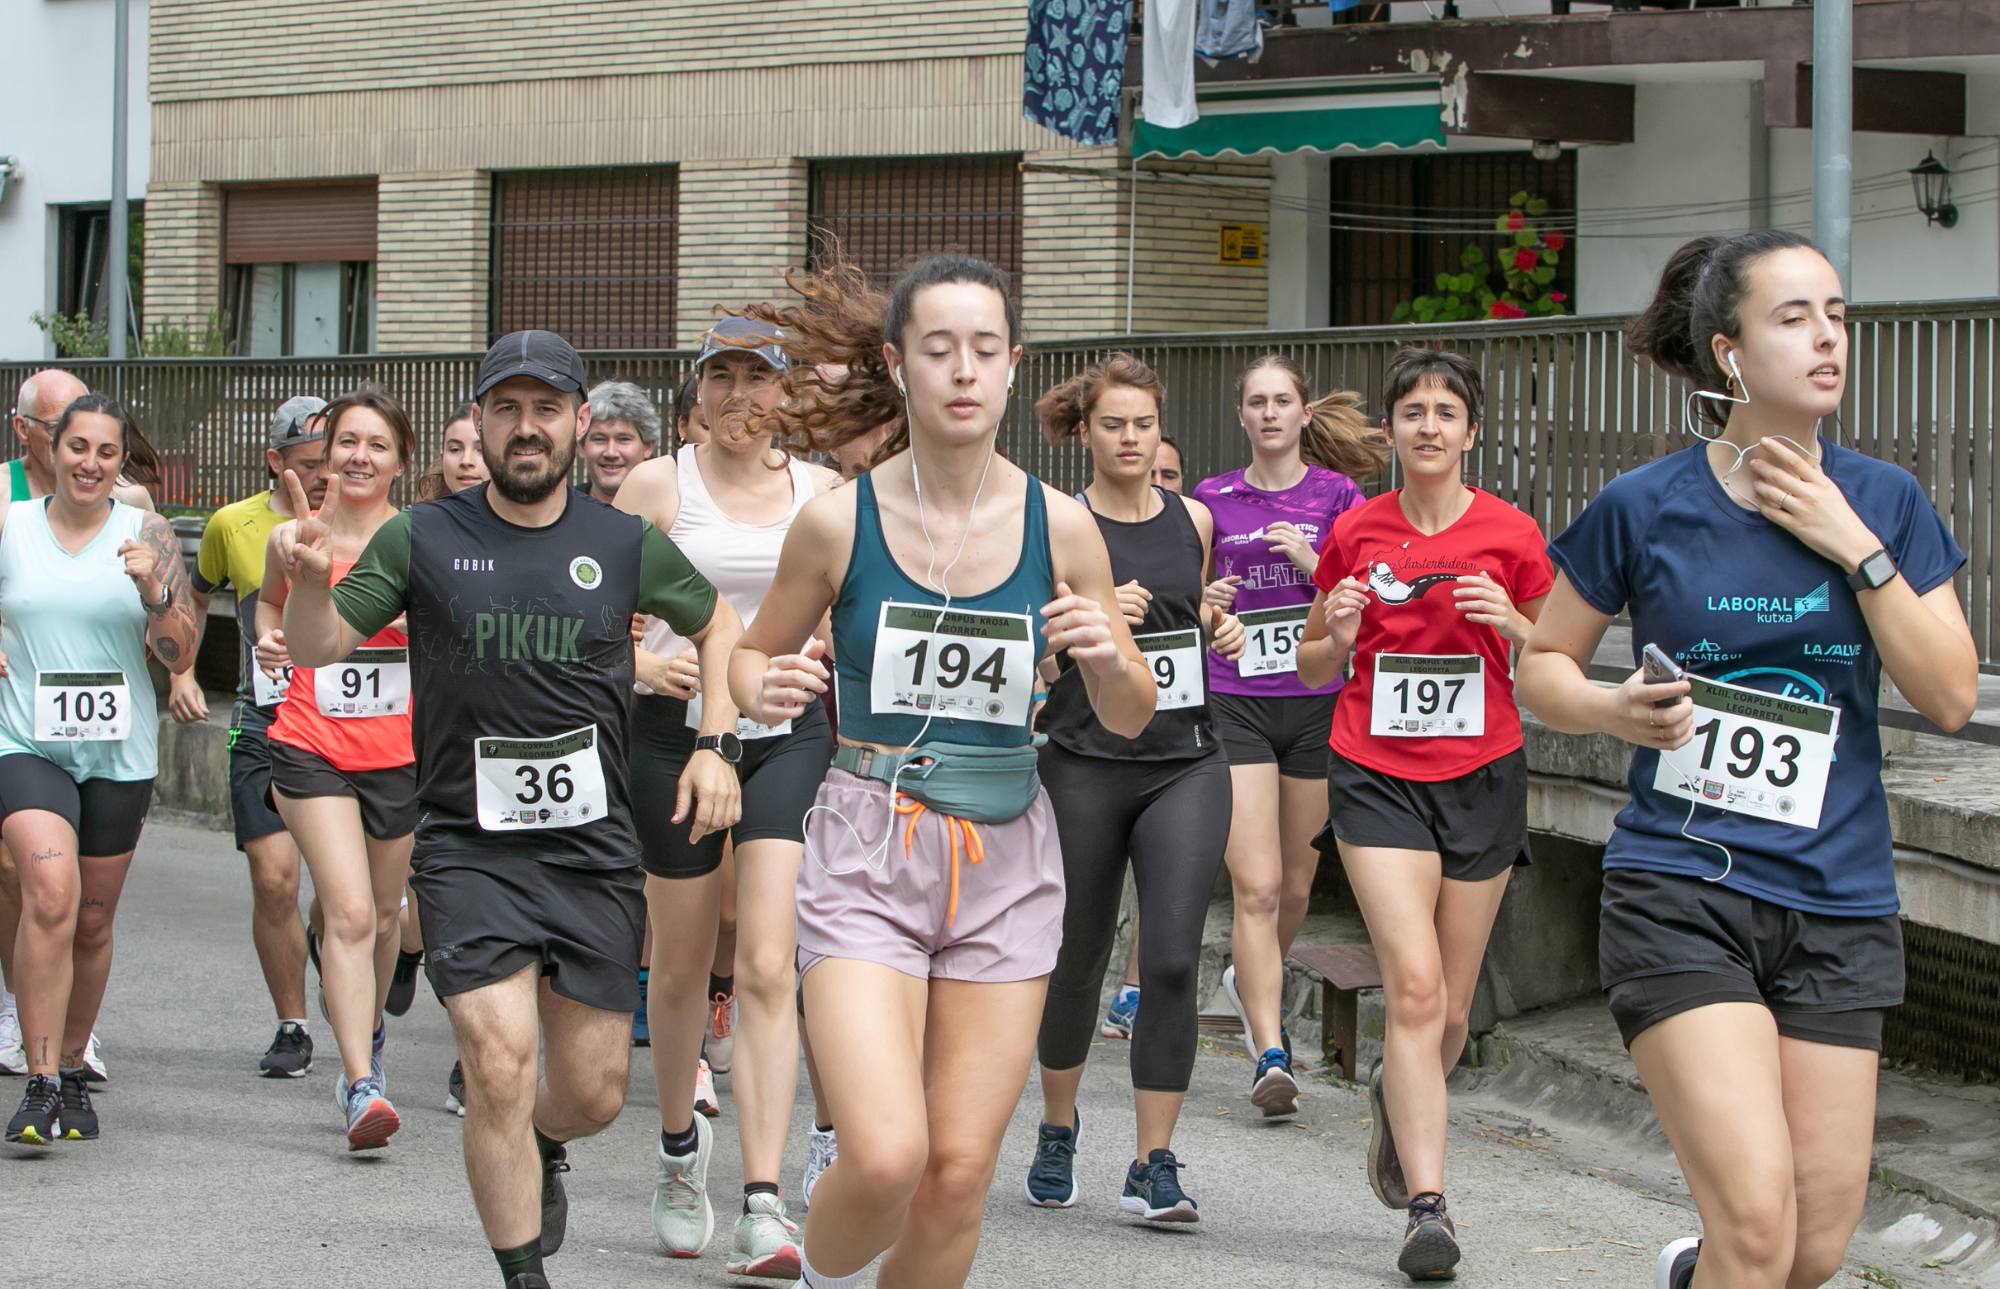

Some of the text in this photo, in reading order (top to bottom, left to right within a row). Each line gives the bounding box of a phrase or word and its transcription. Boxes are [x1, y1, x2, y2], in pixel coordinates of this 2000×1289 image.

[454, 558, 495, 571] GOBIK
[1707, 596, 1792, 611] LABORAL
[1757, 613, 1793, 623] kutxa
[980, 617, 1009, 626] KROSA
[476, 613, 585, 663] PIKUK
[905, 639, 1007, 693] 194
[341, 668, 380, 698] 91
[1393, 679, 1465, 715] 197
[54, 691, 117, 722] 103
[1706, 685, 1731, 699] XLIII.
[1733, 691, 1772, 708] CORPUS
[1777, 702, 1809, 716] KROSA
[1726, 703, 1784, 723] LEGORRETA
[519, 749, 566, 758] LEGORRETA
[522, 742, 554, 750] CORPUS
[557, 736, 578, 747] KROSA
[1695, 718, 1801, 787] 193
[515, 763, 575, 805] 36
